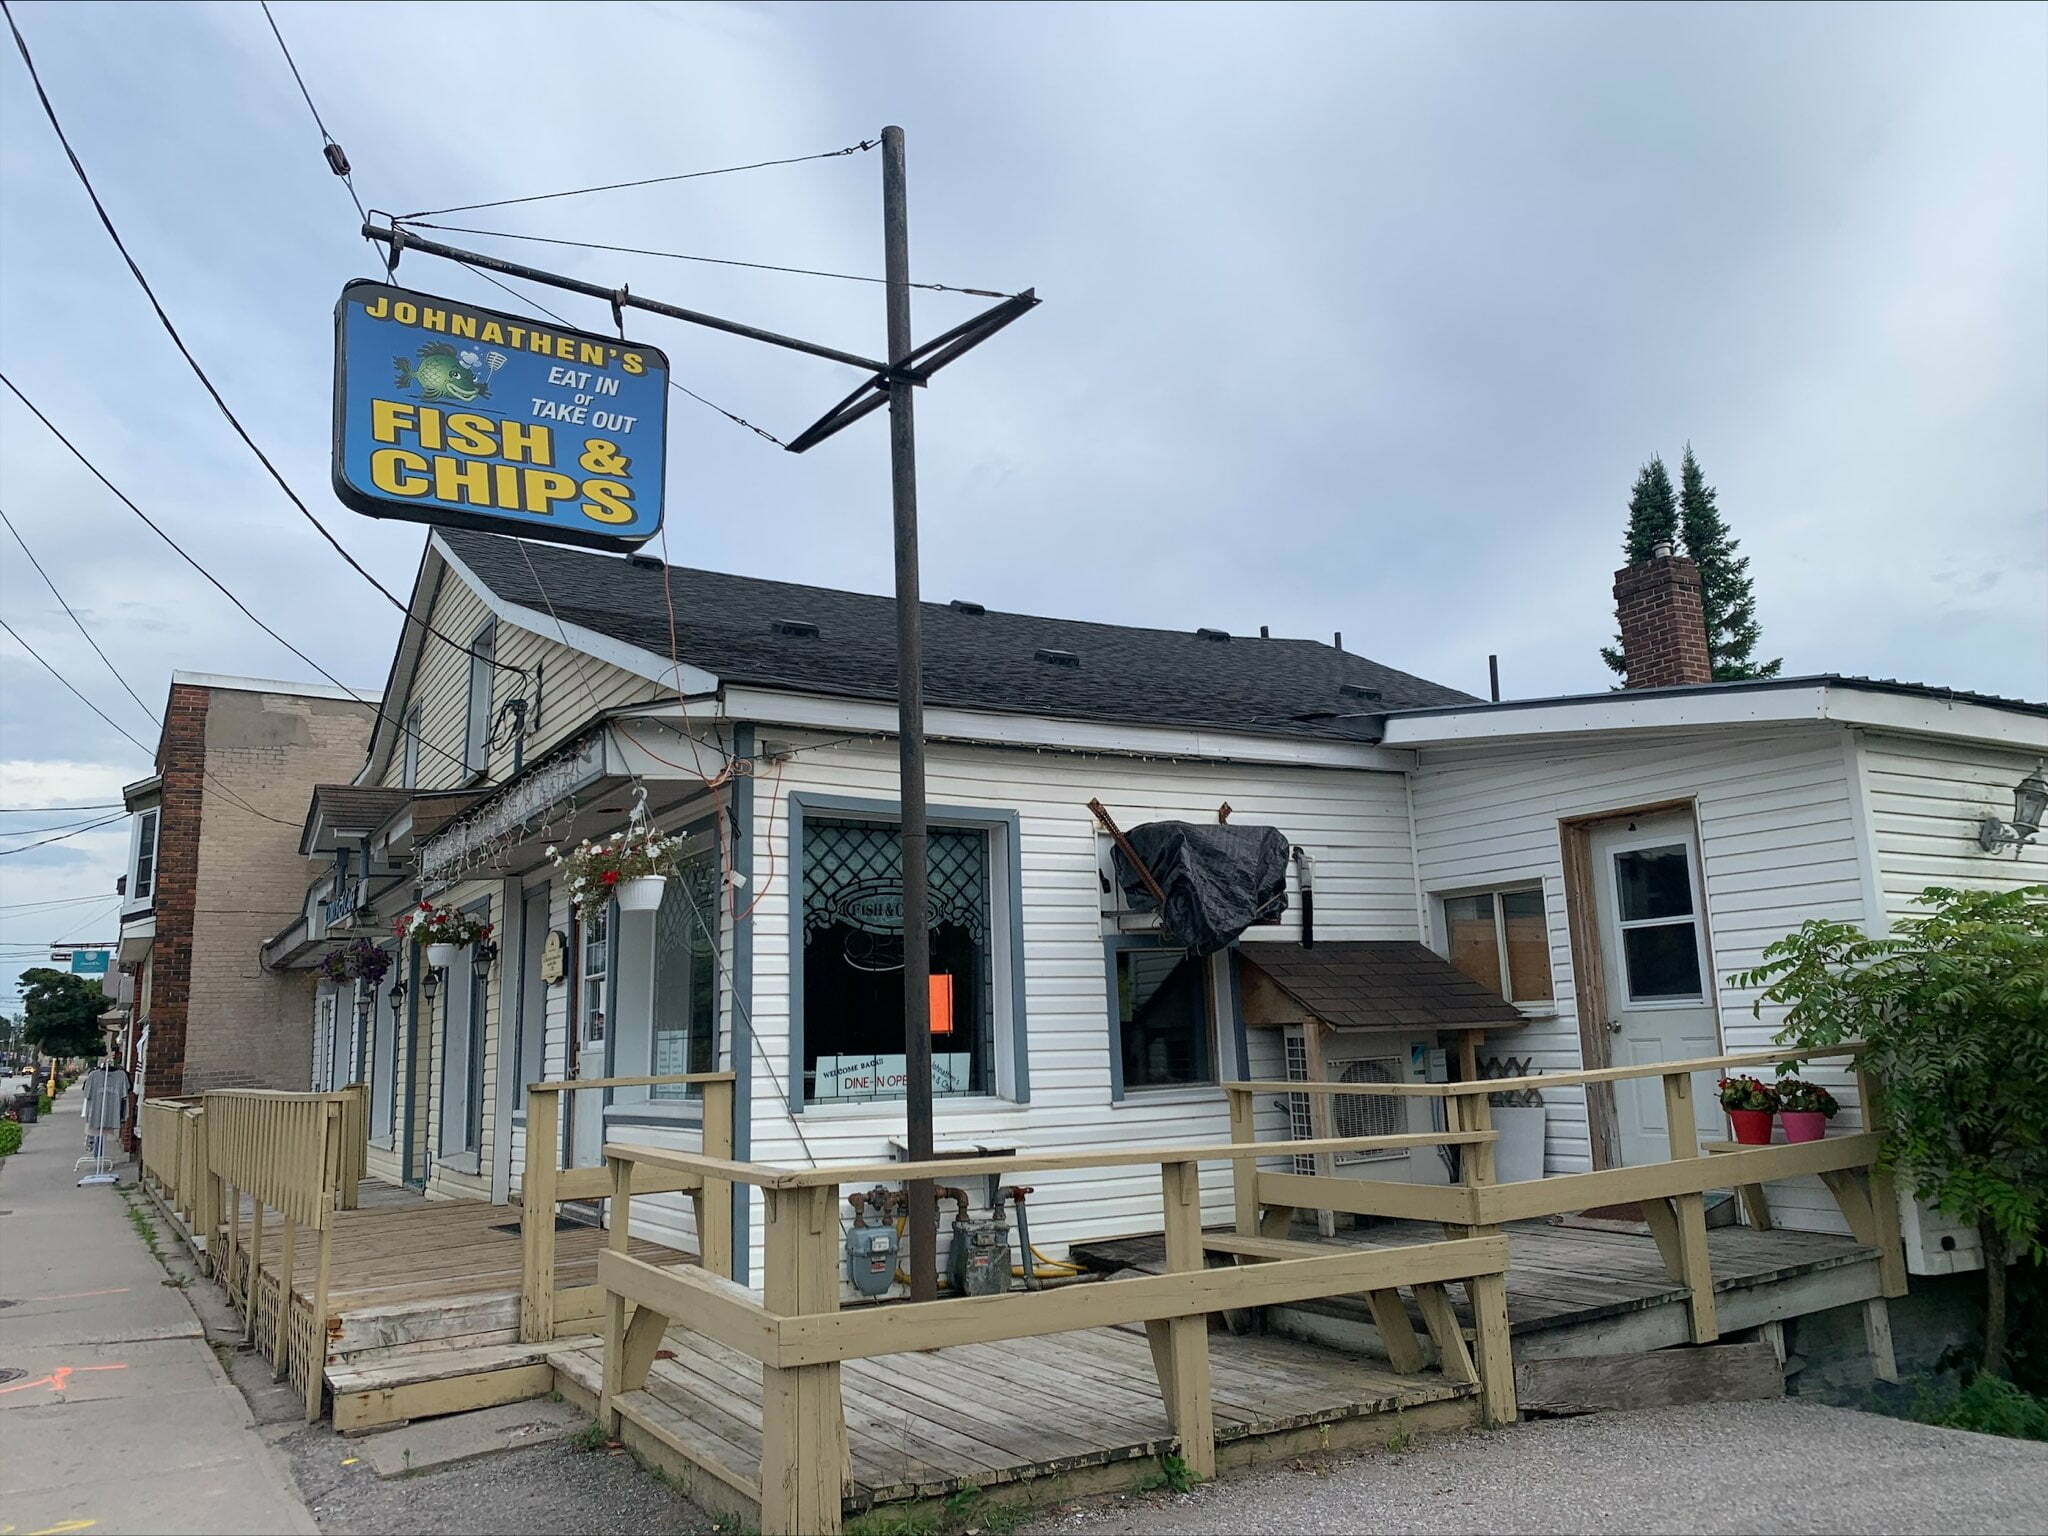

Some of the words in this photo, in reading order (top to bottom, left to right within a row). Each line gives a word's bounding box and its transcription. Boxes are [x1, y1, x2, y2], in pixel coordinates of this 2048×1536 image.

[366, 297, 645, 375] JOHNATHEN'S
[548, 366, 592, 390] EAT
[594, 375, 620, 397] IN
[574, 392, 594, 406] or
[531, 397, 586, 425] TAKE
[591, 410, 638, 434] OUT
[371, 398, 552, 467] FISH
[579, 438, 632, 478] &
[370, 448, 636, 524] CHIPS
[852, 903, 882, 916] FISH
[886, 903, 894, 917] &
[823, 1063, 858, 1079] WELCOME
[844, 1075, 885, 1089] DINE-N
[887, 1074, 908, 1087] OPE
